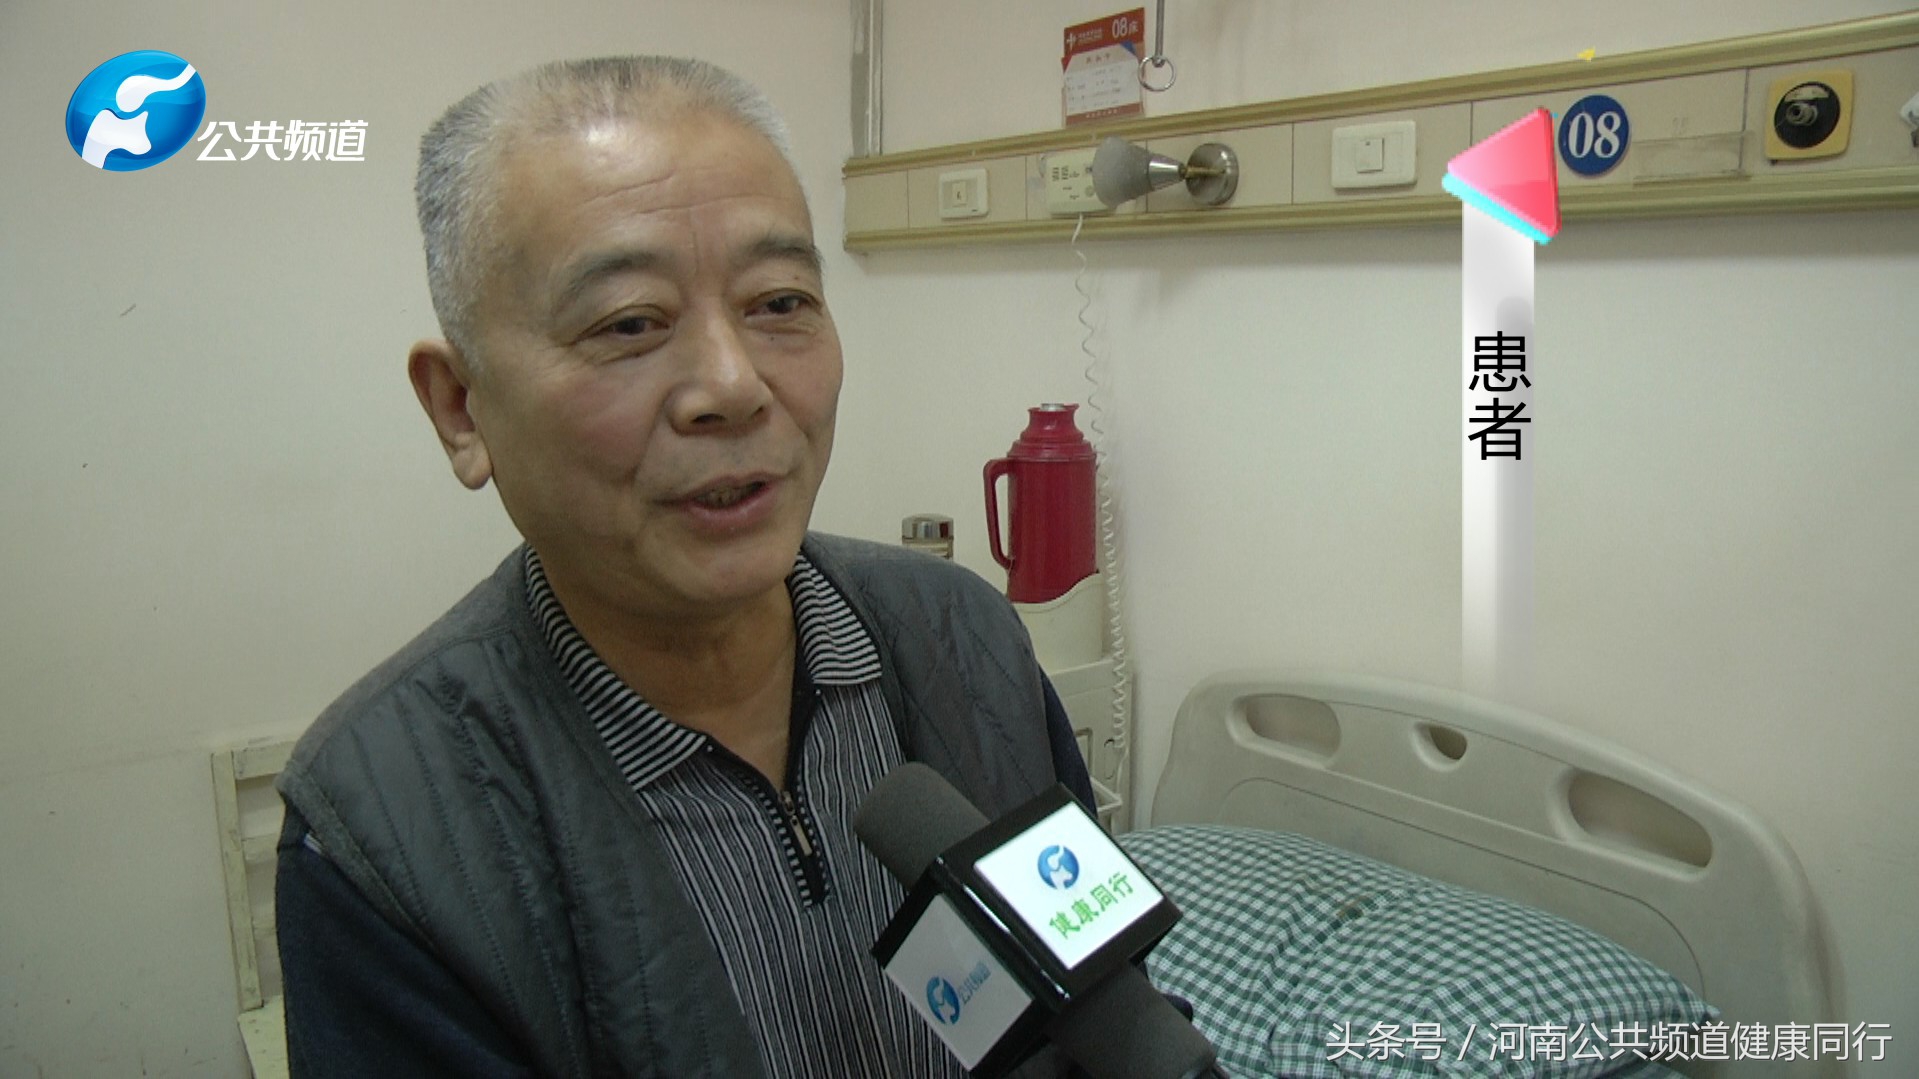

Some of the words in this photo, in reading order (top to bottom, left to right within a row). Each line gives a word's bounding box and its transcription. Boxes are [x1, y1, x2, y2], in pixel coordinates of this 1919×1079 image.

[1568, 111, 1622, 159] 08
[1049, 871, 1134, 939] 健康同行
